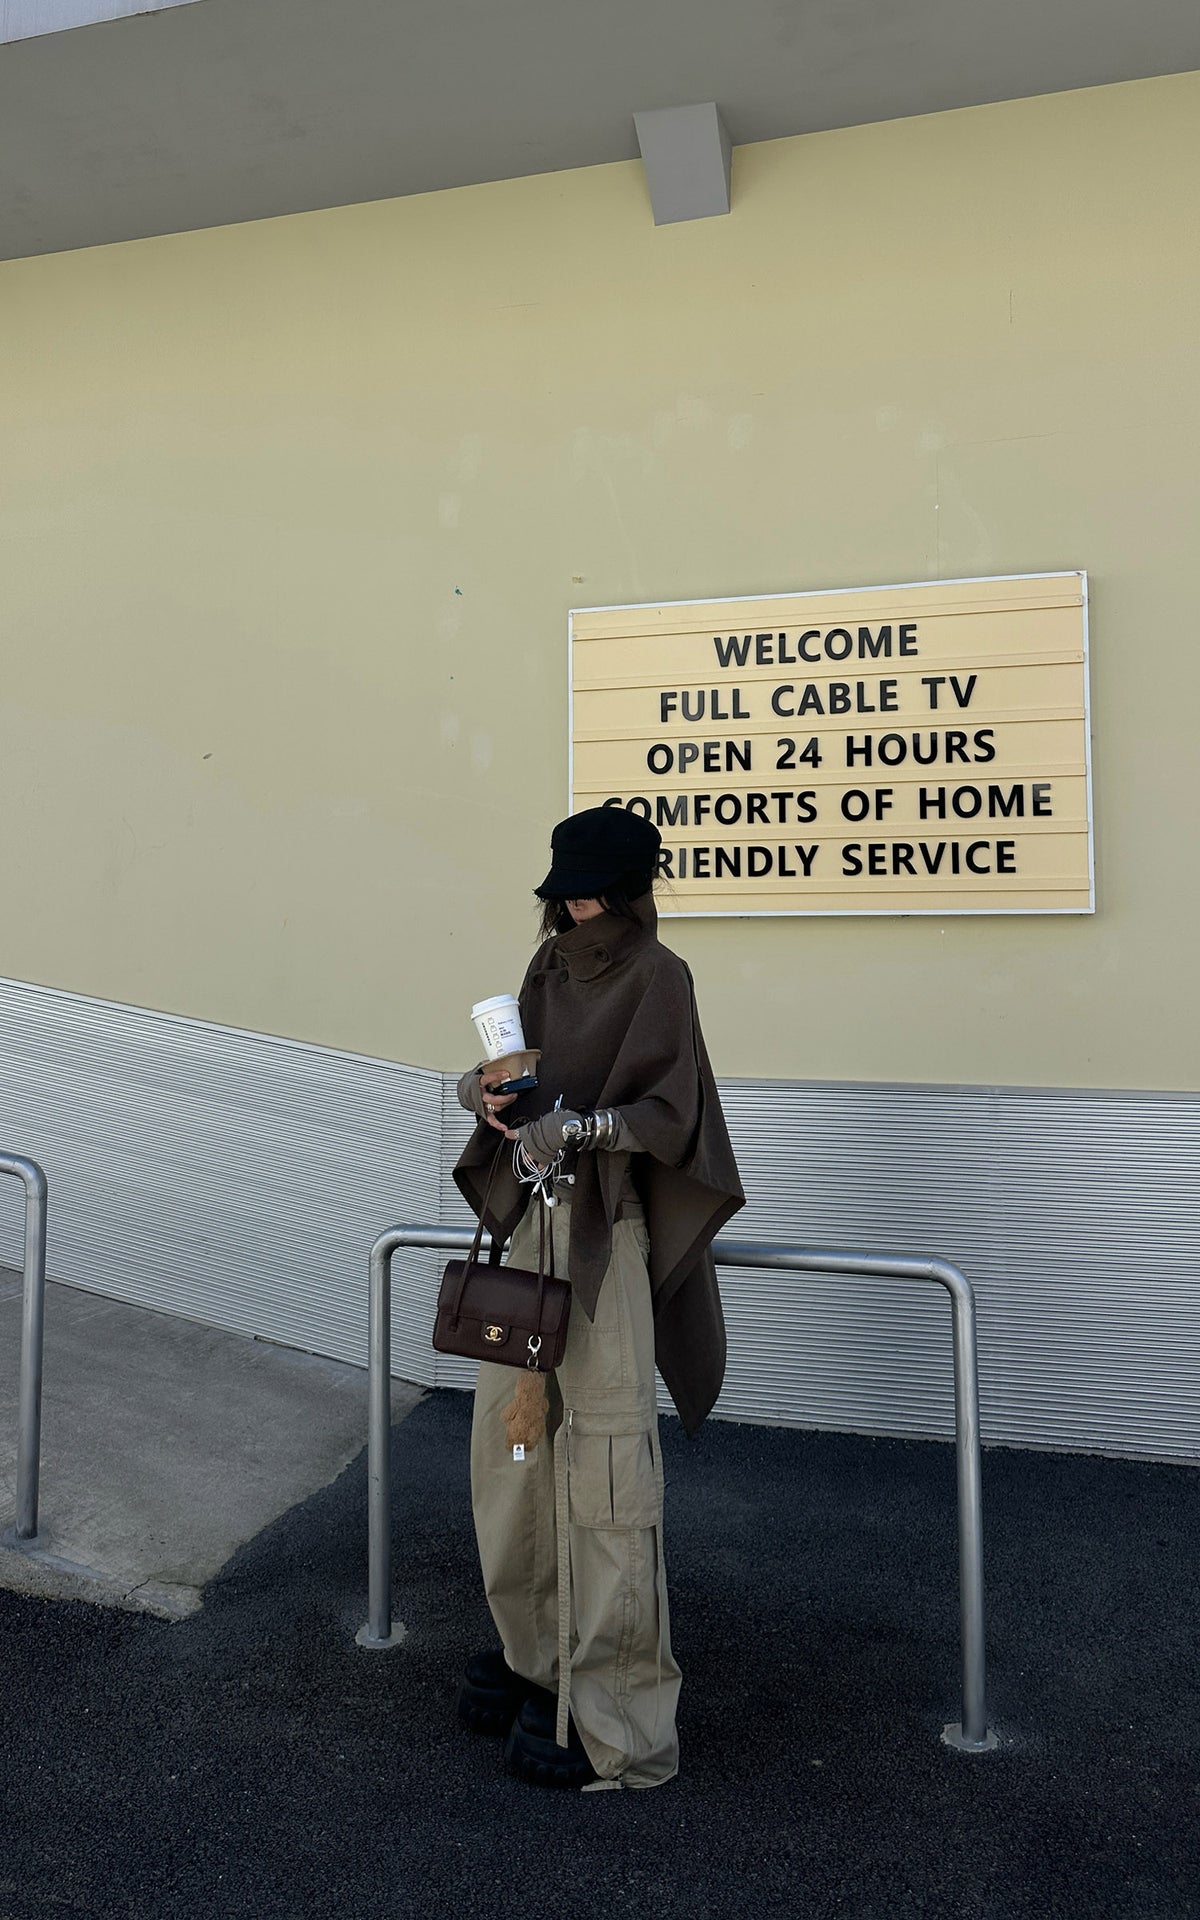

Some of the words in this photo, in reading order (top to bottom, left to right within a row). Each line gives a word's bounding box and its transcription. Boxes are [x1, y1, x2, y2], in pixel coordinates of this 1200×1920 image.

[713, 623, 919, 668] WELCOME
[660, 688, 751, 723] FULL
[771, 679, 899, 718] CABLE
[921, 674, 978, 710] TV
[646, 740, 752, 775] OPEN
[775, 736, 823, 770] 24
[846, 729, 996, 768] HOURS
[840, 788, 894, 823] OF
[918, 783, 1053, 820] HOME
[655, 844, 820, 879] RIENDLY
[841, 840, 1017, 877] SERVICE
